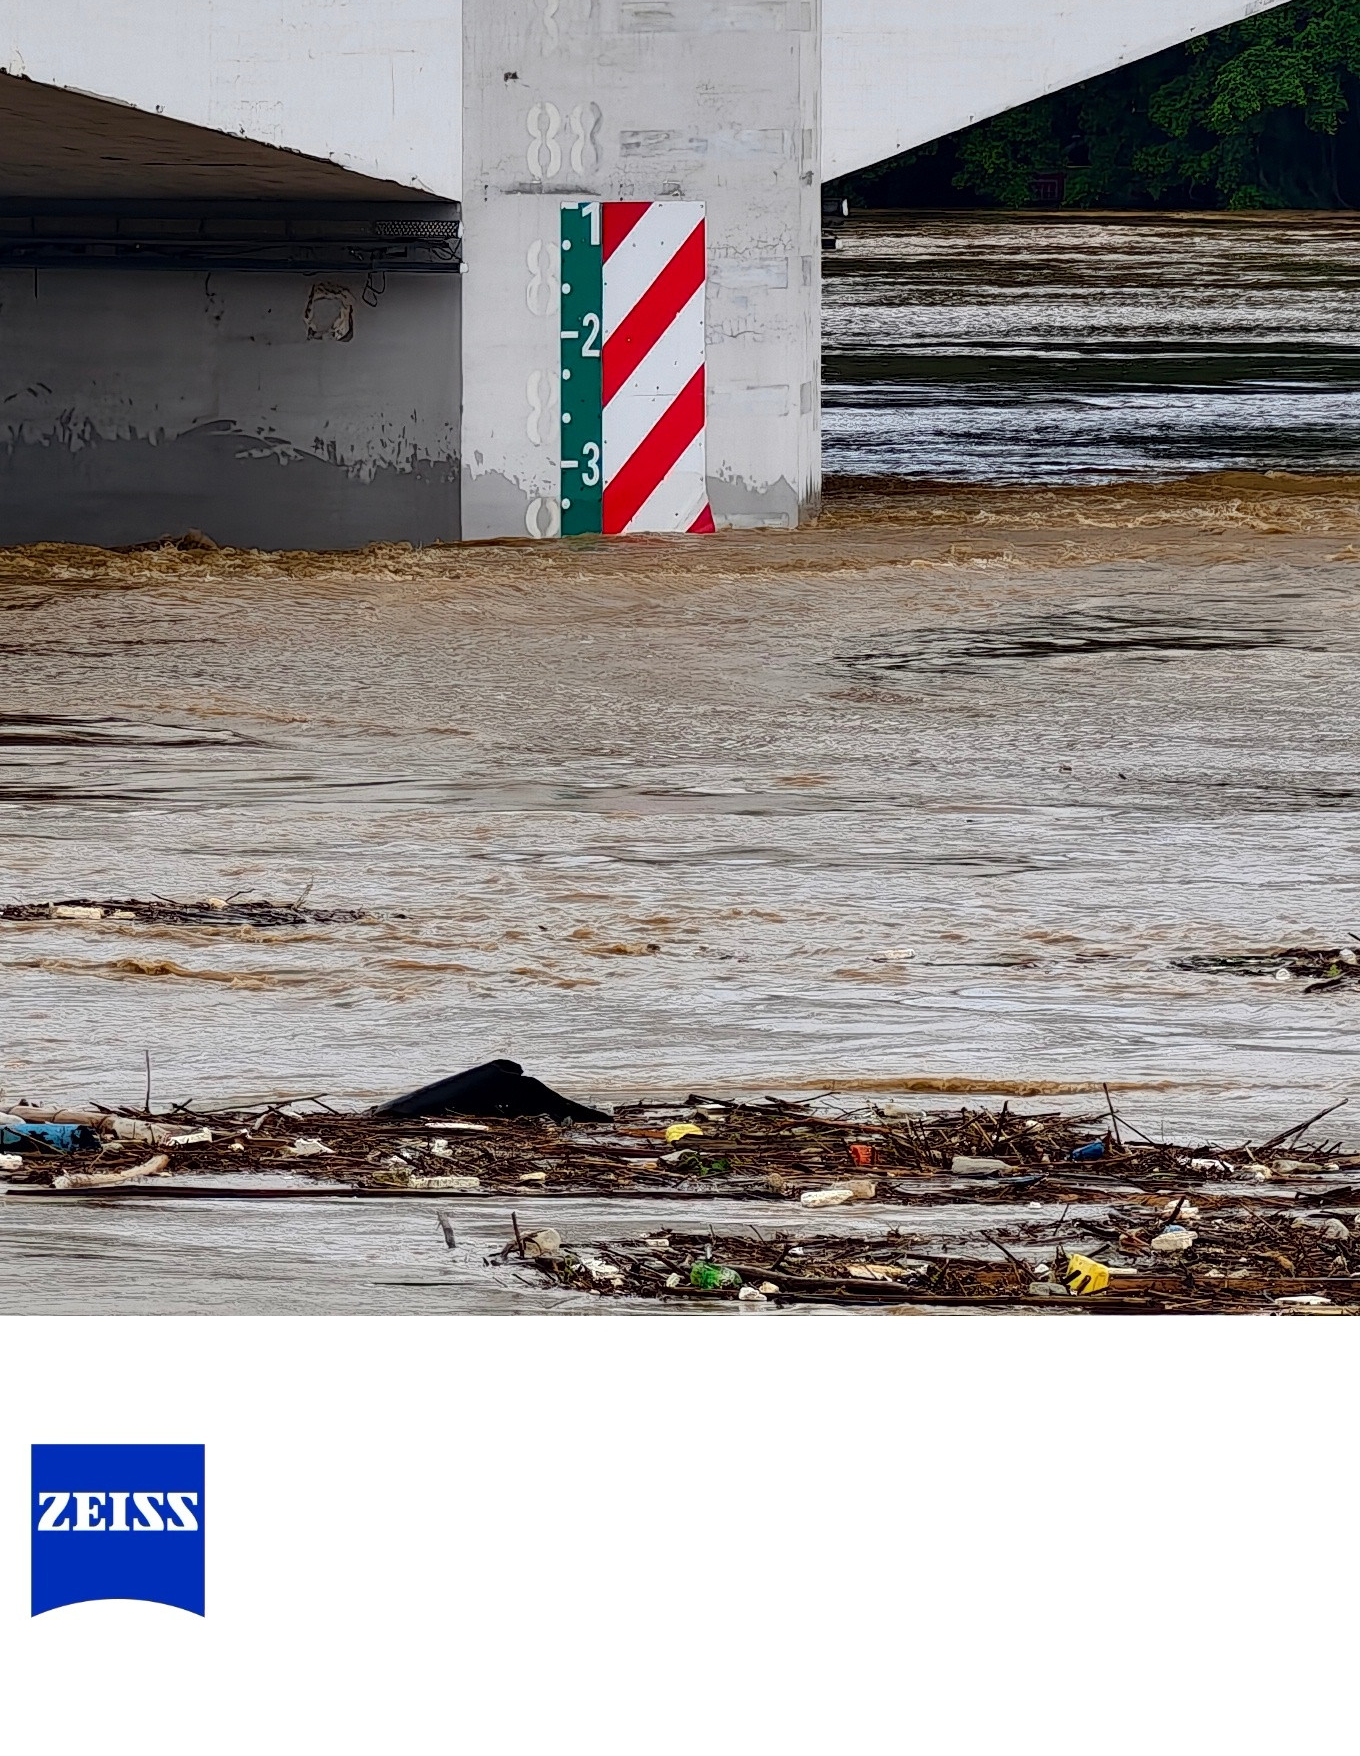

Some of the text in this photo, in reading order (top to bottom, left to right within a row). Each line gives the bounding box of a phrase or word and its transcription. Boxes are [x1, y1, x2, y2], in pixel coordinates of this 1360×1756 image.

[526, 100, 604, 179] 88
[581, 201, 601, 245] 1
[581, 312, 601, 357] 2
[581, 441, 601, 486] 3
